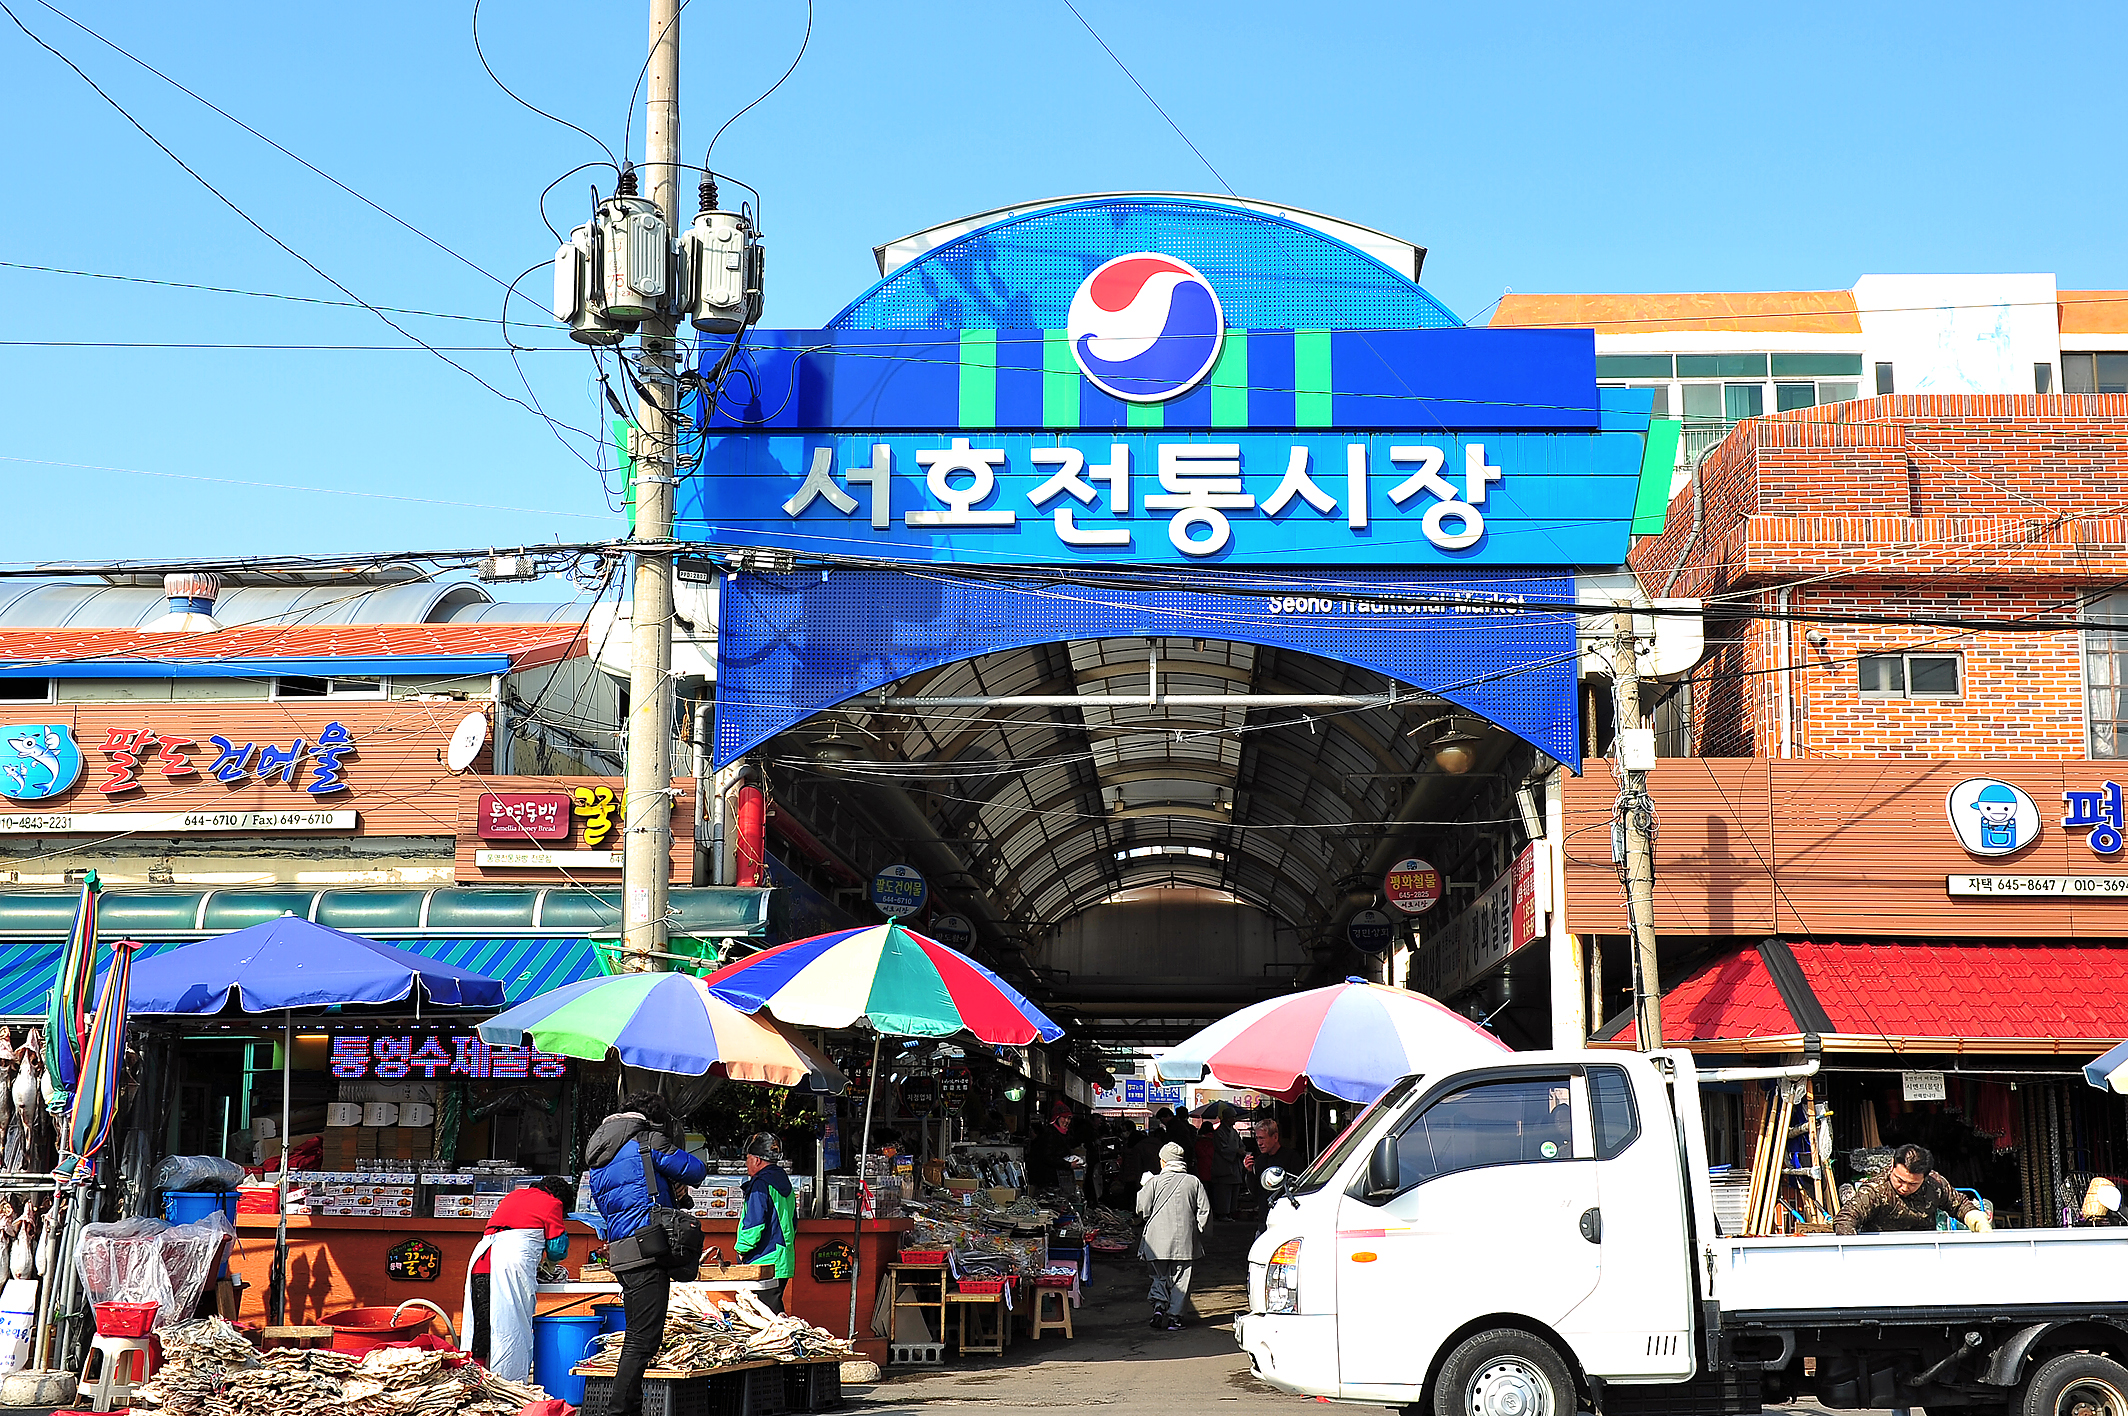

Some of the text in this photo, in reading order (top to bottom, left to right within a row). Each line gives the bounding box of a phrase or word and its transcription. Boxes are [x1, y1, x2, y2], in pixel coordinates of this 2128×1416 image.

[781, 437, 1503, 557] 서호전통시장
[184, 815, 238, 826] 644-6710
[538, 824, 556, 832] Bread
[876, 879, 922, 896] 팔도건어물
[1389, 874, 1436, 890] 평화철물
[1968, 878, 1993, 892] 자택
[1997, 878, 2056, 891] 645-8647
[882, 896, 912, 905] 644-6710
[1352, 928, 1390, 939] 경민상회
[907, 1093, 932, 1101] 지정업체
